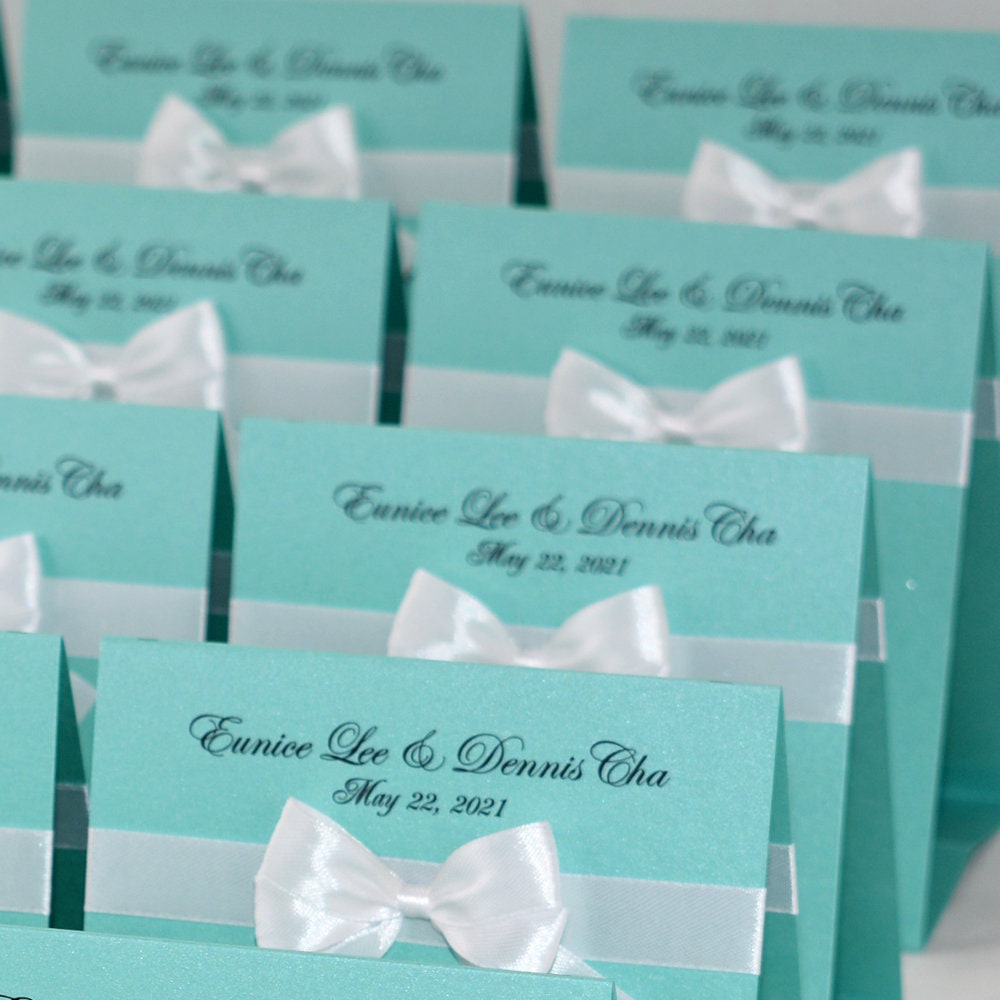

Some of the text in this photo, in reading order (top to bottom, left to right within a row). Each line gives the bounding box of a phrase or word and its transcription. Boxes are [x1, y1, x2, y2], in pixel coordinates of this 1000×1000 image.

[56, 453, 124, 500] Cha
[333, 481, 778, 547] Eunice Lee & Dennis Cha
[467, 539, 631, 576] May 22, 2021
[189, 714, 670, 788] Eunice Lee & Dennis Cha
[332, 777, 507, 817] May 22, 2021
